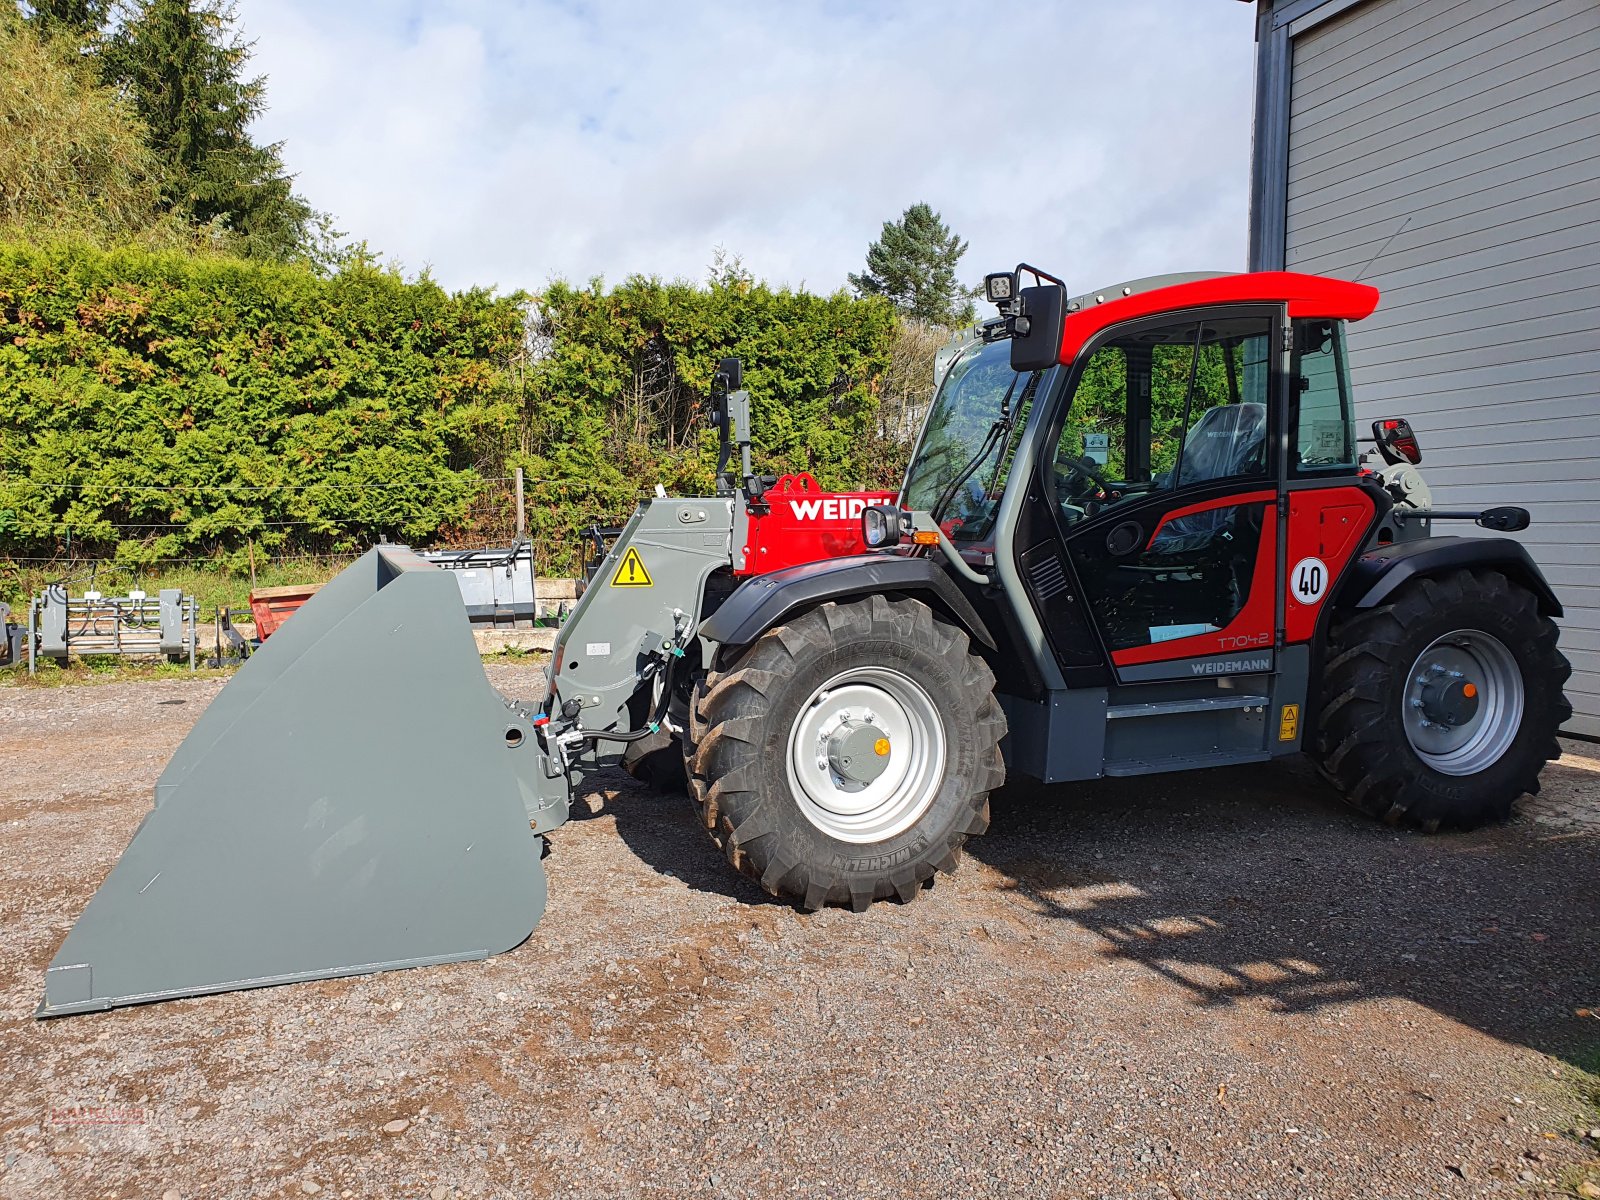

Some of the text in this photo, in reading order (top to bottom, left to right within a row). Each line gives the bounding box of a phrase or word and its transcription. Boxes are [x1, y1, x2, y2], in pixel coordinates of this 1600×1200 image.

[790, 498, 890, 520] WEID
[1299, 566, 1321, 595] 40
[1218, 632, 1269, 649] T7042
[1191, 659, 1270, 674] WEIDEMANN
[832, 847, 911, 870] MICHELIN
